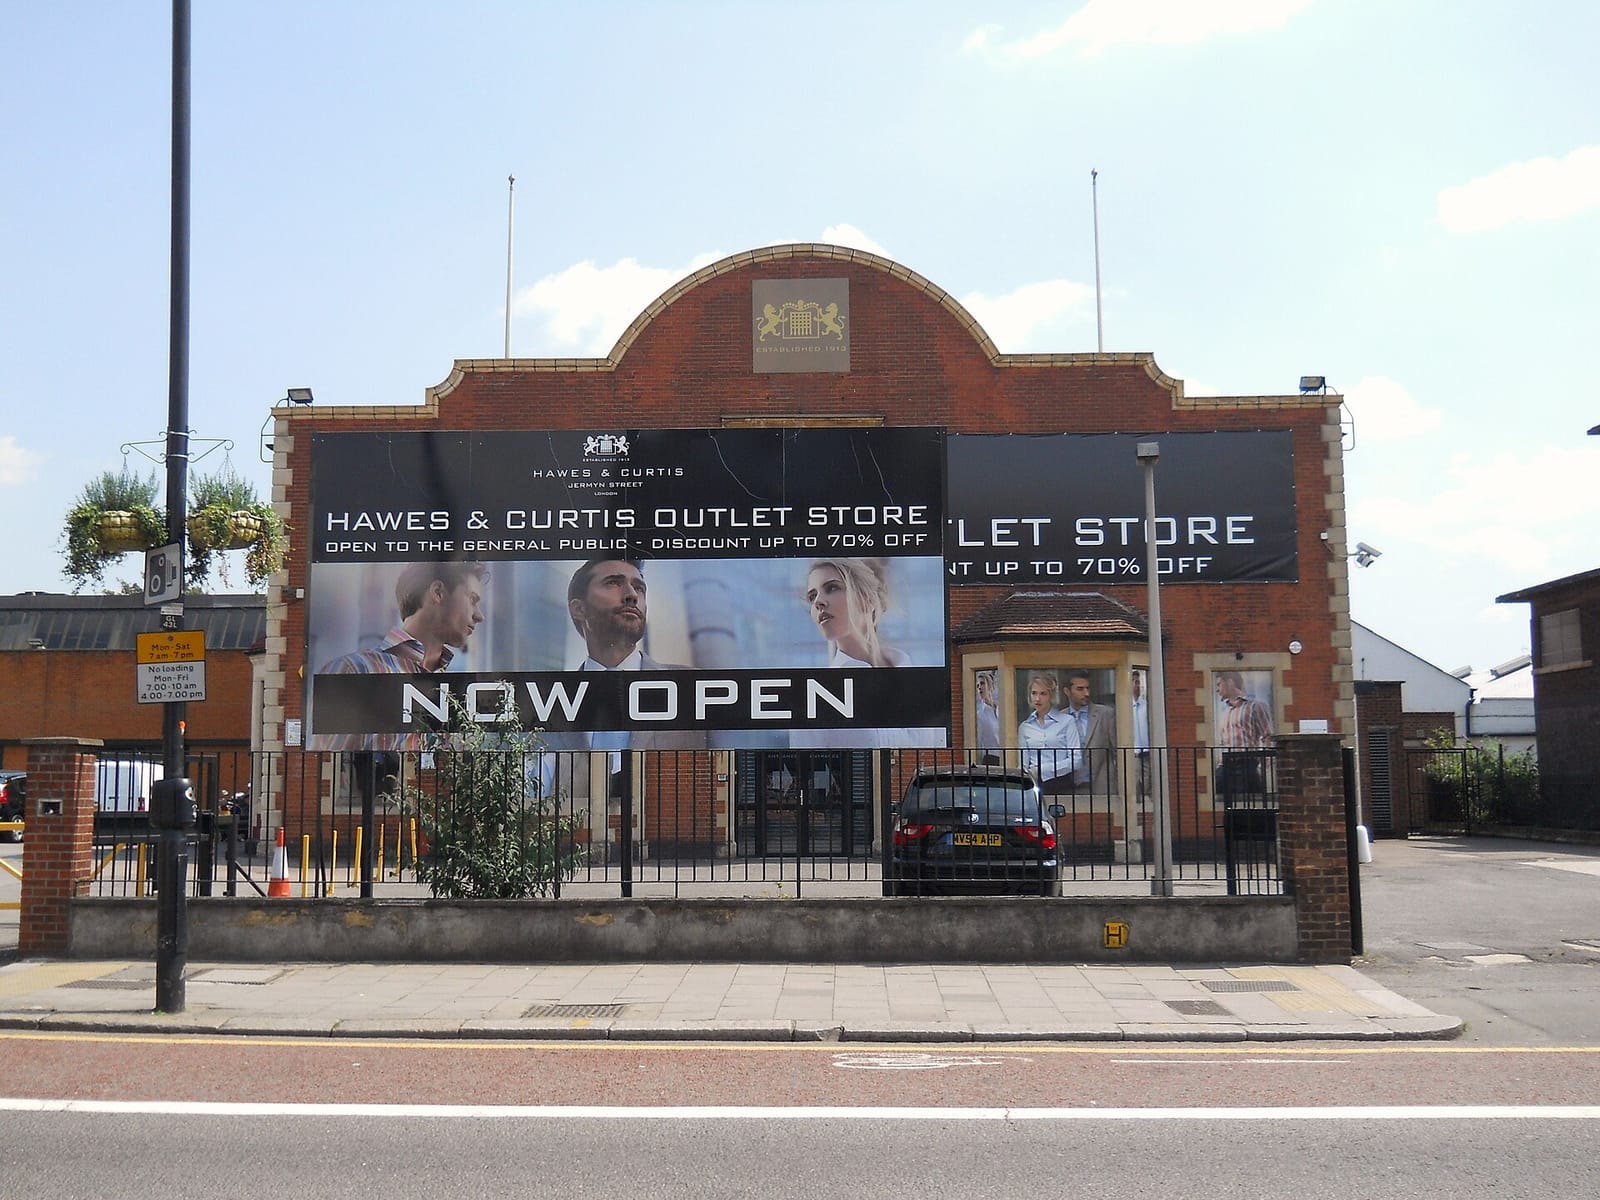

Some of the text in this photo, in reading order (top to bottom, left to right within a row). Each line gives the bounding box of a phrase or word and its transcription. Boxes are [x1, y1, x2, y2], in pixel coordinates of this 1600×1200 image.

[533, 467, 684, 478] HAWES & CURTIS
[327, 505, 928, 531] HAWES & CURTIS OUTLET STORE
[947, 516, 1255, 547] LET STORE
[325, 541, 377, 553] OPEN
[385, 541, 409, 552] TO
[417, 540, 454, 551] THE
[463, 540, 551, 551] GENERAL
[559, 539, 628, 550] PUBLIC
[652, 537, 751, 549] DISCOUNT
[759, 537, 785, 548] UP
[792, 536, 817, 547] TO
[827, 534, 874, 547] 70%
[884, 533, 928, 546] OFF
[985, 561, 1019, 576] UP
[1030, 561, 1063, 575] TO
[1077, 557, 1141, 575] 70%
[1156, 557, 1213, 574] OFF
[162, 665, 194, 673] loading
[189, 690, 203, 699] pm
[402, 678, 854, 723] NOW OPEN
[1106, 925, 1122, 945] H
